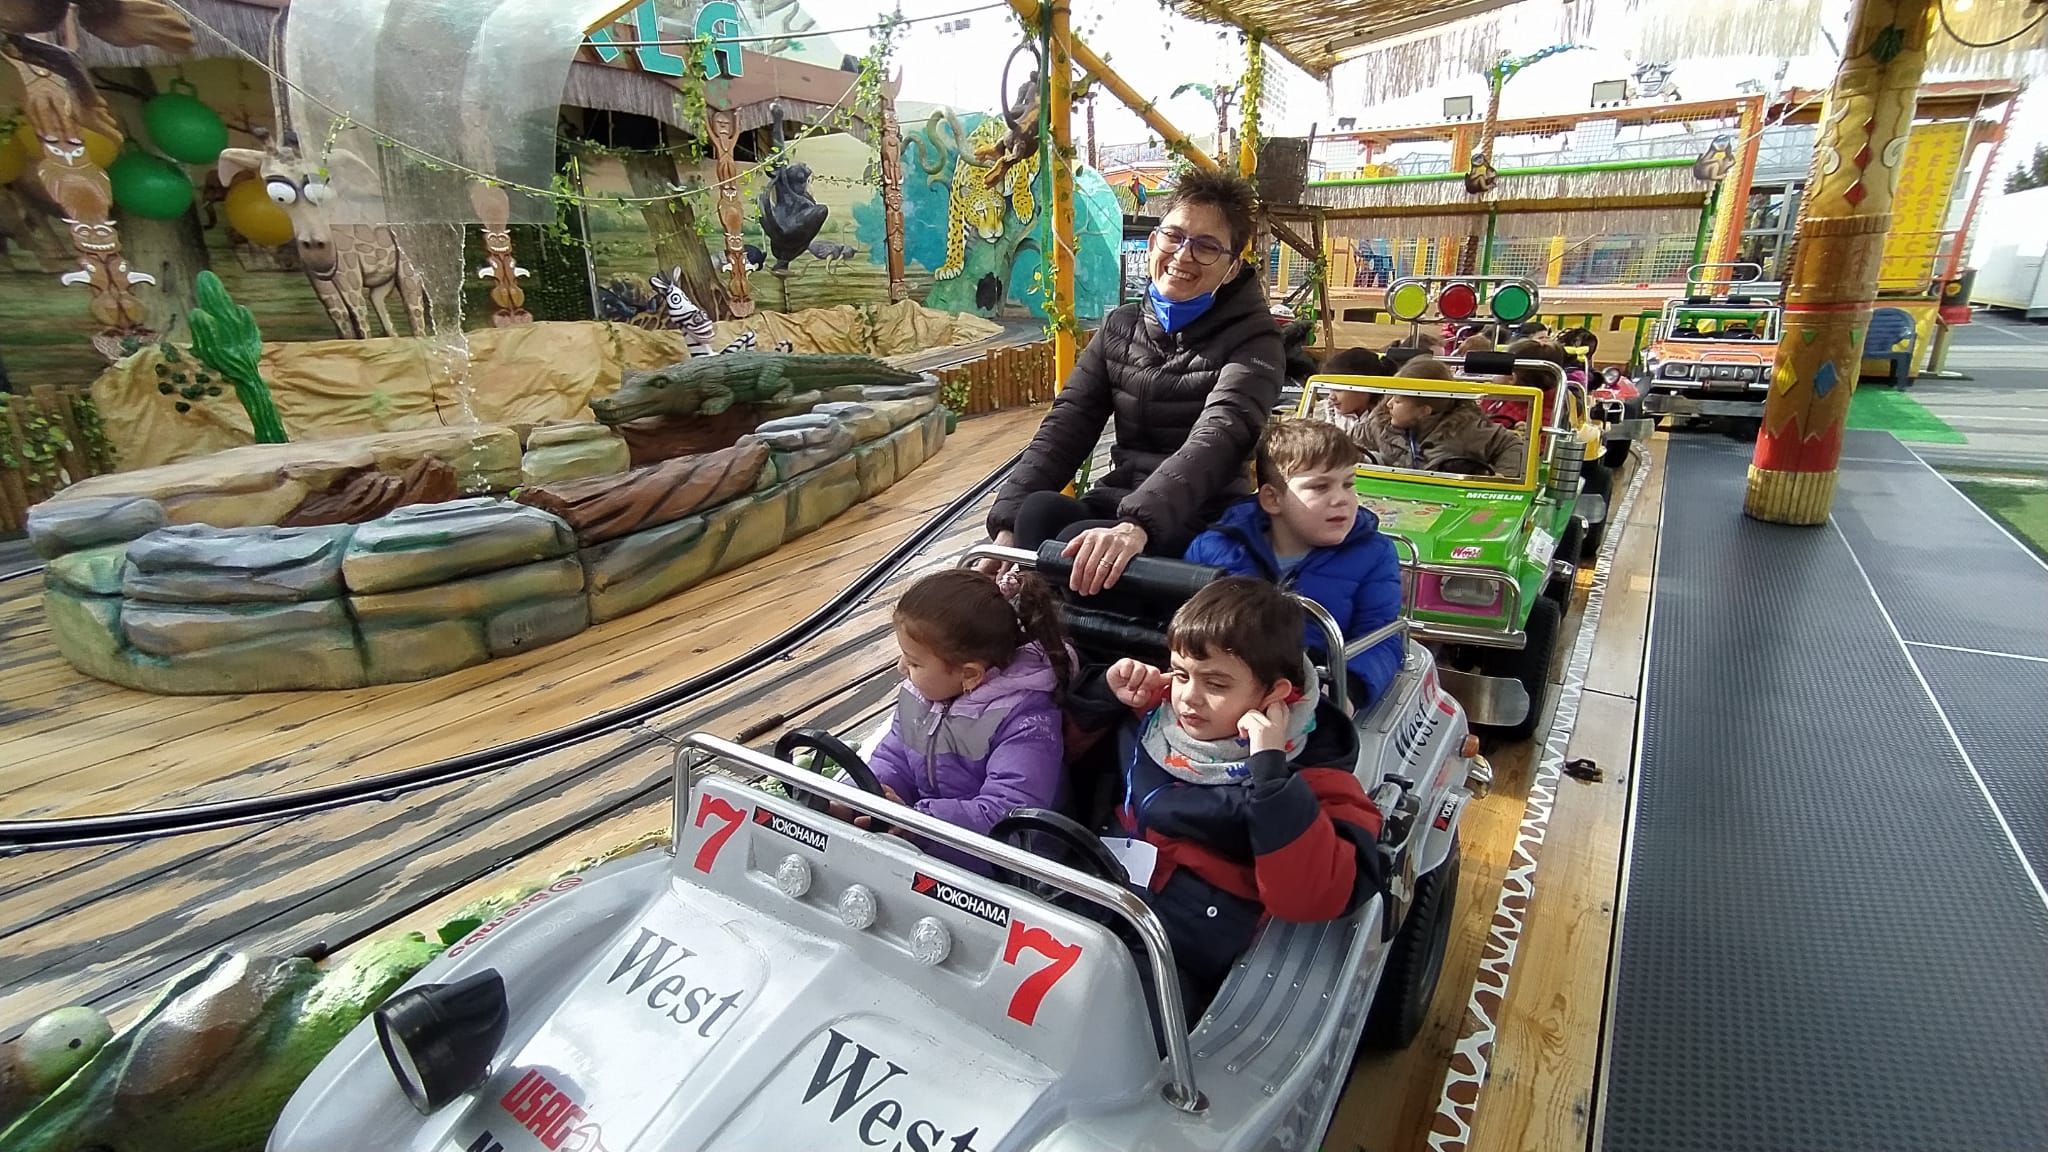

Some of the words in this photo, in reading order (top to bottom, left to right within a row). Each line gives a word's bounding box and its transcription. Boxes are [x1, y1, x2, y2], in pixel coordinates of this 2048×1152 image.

[1466, 491, 1524, 501] MICHELIN
[1395, 698, 1439, 766] West
[694, 793, 748, 875] 7
[770, 815, 828, 851] YOKOHAMA
[448, 892, 549, 958] brembo
[935, 882, 1008, 925] YOKOHAMA
[606, 926, 744, 1037] West
[1002, 920, 1083, 1027] 7
[500, 1068, 588, 1151] USAG
